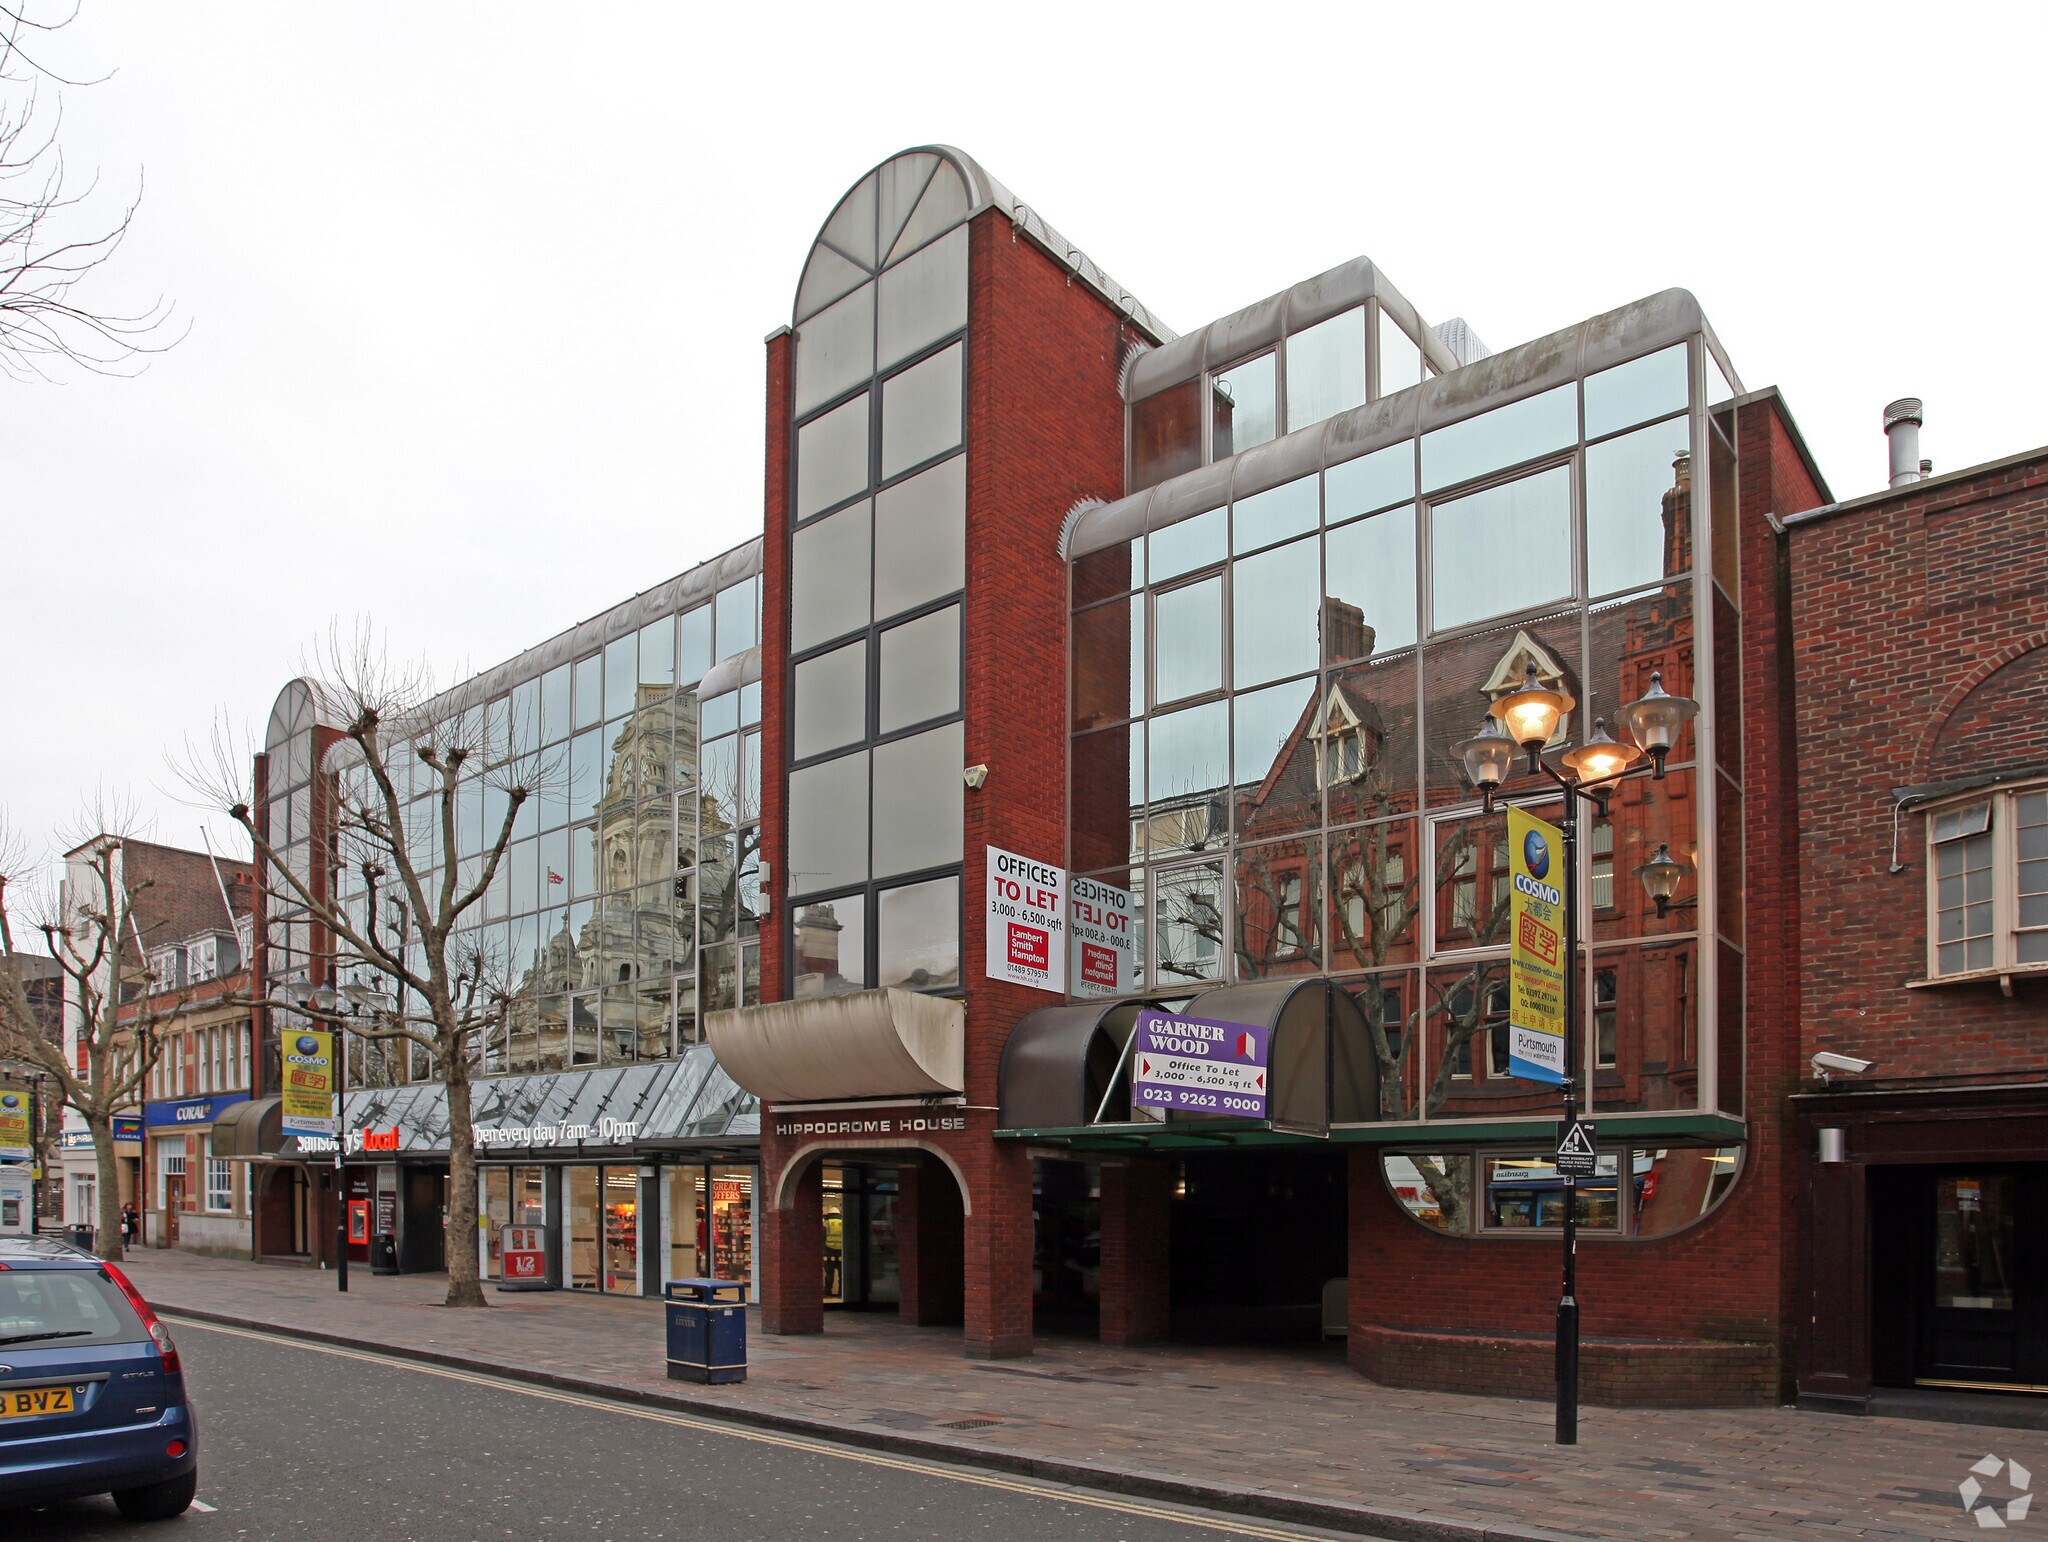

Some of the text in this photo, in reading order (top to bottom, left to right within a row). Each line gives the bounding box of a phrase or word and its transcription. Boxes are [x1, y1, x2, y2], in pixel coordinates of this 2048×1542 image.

[997, 854, 1058, 888] OFFICES
[994, 876, 1059, 912] TO LET
[1515, 874, 1560, 906] COSMO
[991, 900, 1016, 918] 3,000
[1021, 909, 1046, 926] 6,500
[1046, 917, 1063, 932] sqft
[1524, 897, 1552, 923] 大都会
[1011, 927, 1043, 944] Lambert
[1011, 937, 1034, 952] Smith
[1521, 918, 1555, 956] 留学
[1011, 948, 1045, 965] Hampton
[1007, 963, 1049, 980] 01489 579579
[1148, 1019, 1225, 1042] GARNER
[1148, 1034, 1210, 1055] WOOD
[1518, 1033, 1557, 1055] Portsmouth
[287, 1054, 328, 1066] COSMO
[1169, 1061, 1240, 1077] Office To Let
[1155, 1070, 1185, 1081] 3,000
[1196, 1075, 1225, 1086] 6,500
[1228, 1080, 1239, 1090] sq
[1243, 1081, 1252, 1089] ft
[1143, 1088, 1261, 1112] 023 9262 9000
[176, 1105, 205, 1121] CORAL
[498, 1126, 531, 1147] every
[533, 1121, 558, 1146] day
[558, 1119, 590, 1140] 7am
[598, 1117, 639, 1143] 10pm
[776, 1117, 965, 1136] HIPPODROME HOUSE
[362, 1126, 400, 1151] Local
[713, 1182, 739, 1191] GREAT
[1565, 1176, 1572, 1184] 9
[516, 1256, 535, 1269] 1/2
[675, 1317, 696, 1328] LITTER
[16, 1391, 69, 1413] BVZ
